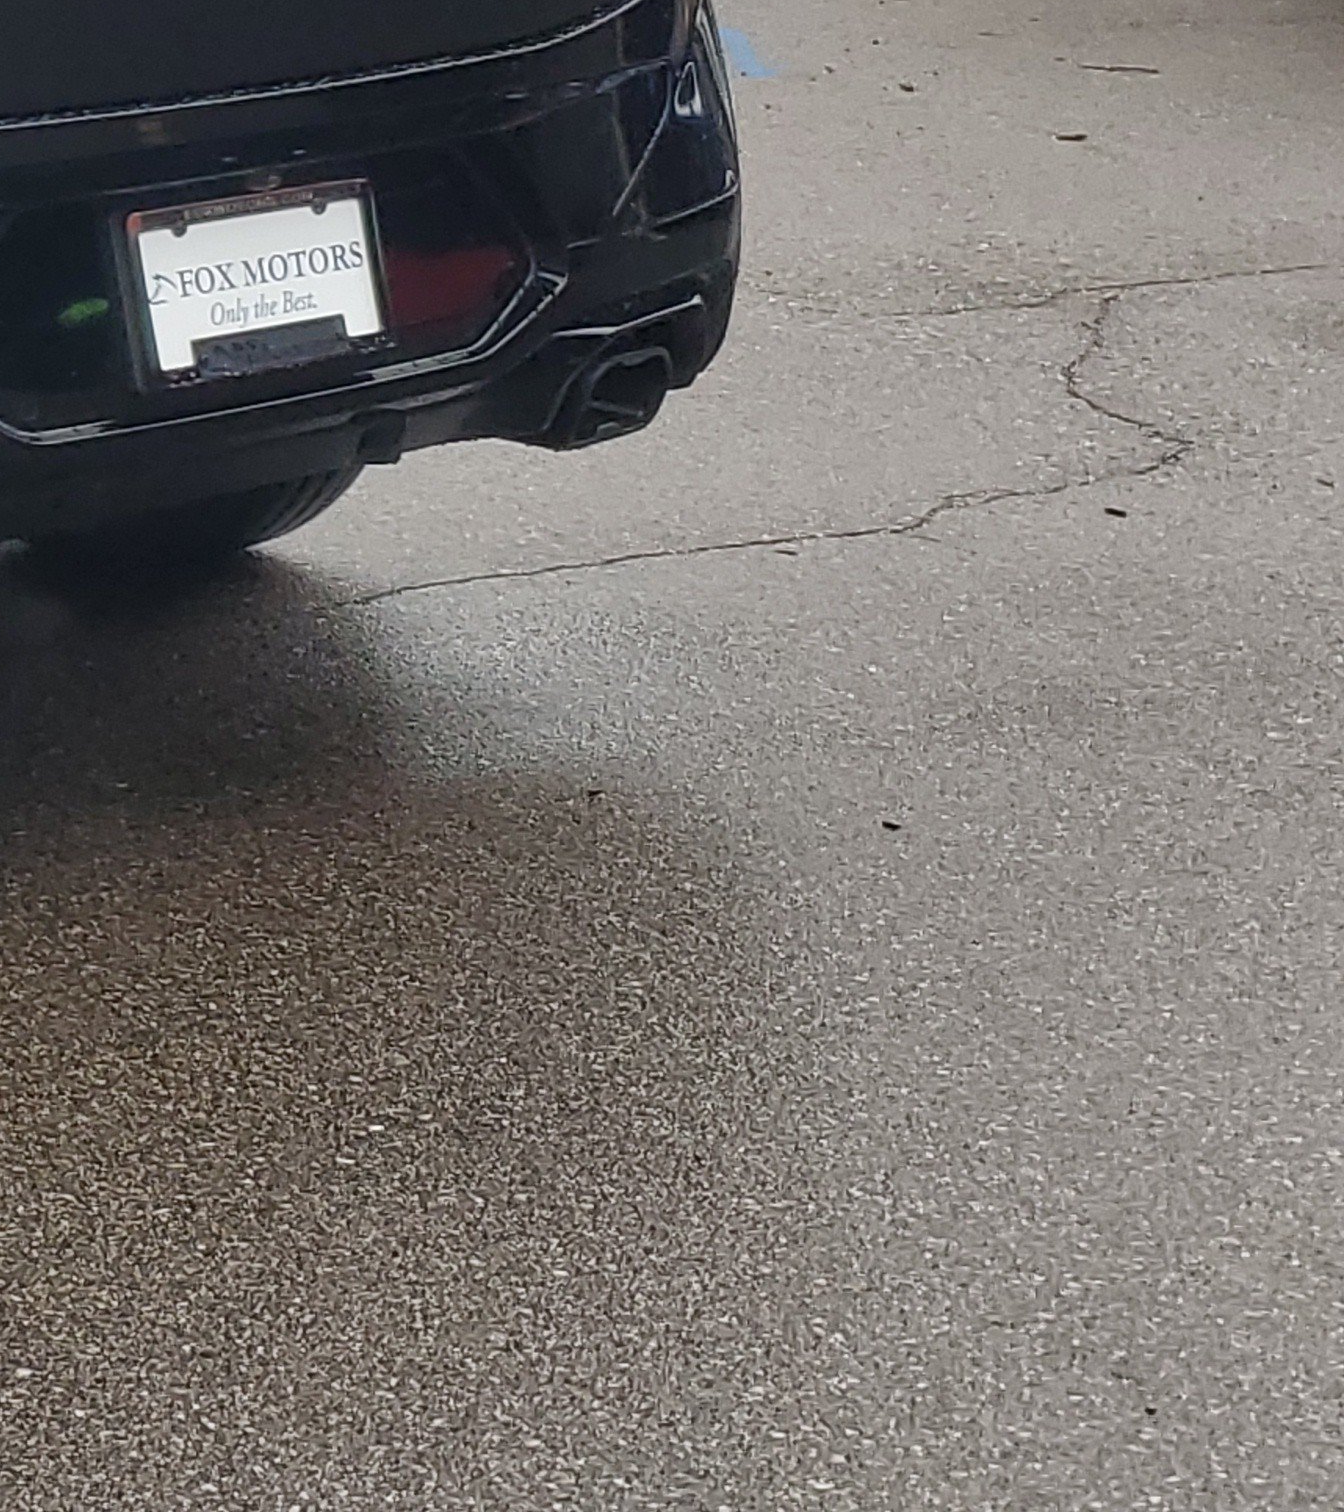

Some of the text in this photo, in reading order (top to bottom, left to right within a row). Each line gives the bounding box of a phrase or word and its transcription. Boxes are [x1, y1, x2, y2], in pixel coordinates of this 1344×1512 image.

[176, 240, 364, 298] FOX MOTORS
[210, 297, 251, 328] Only
[252, 296, 279, 319] the
